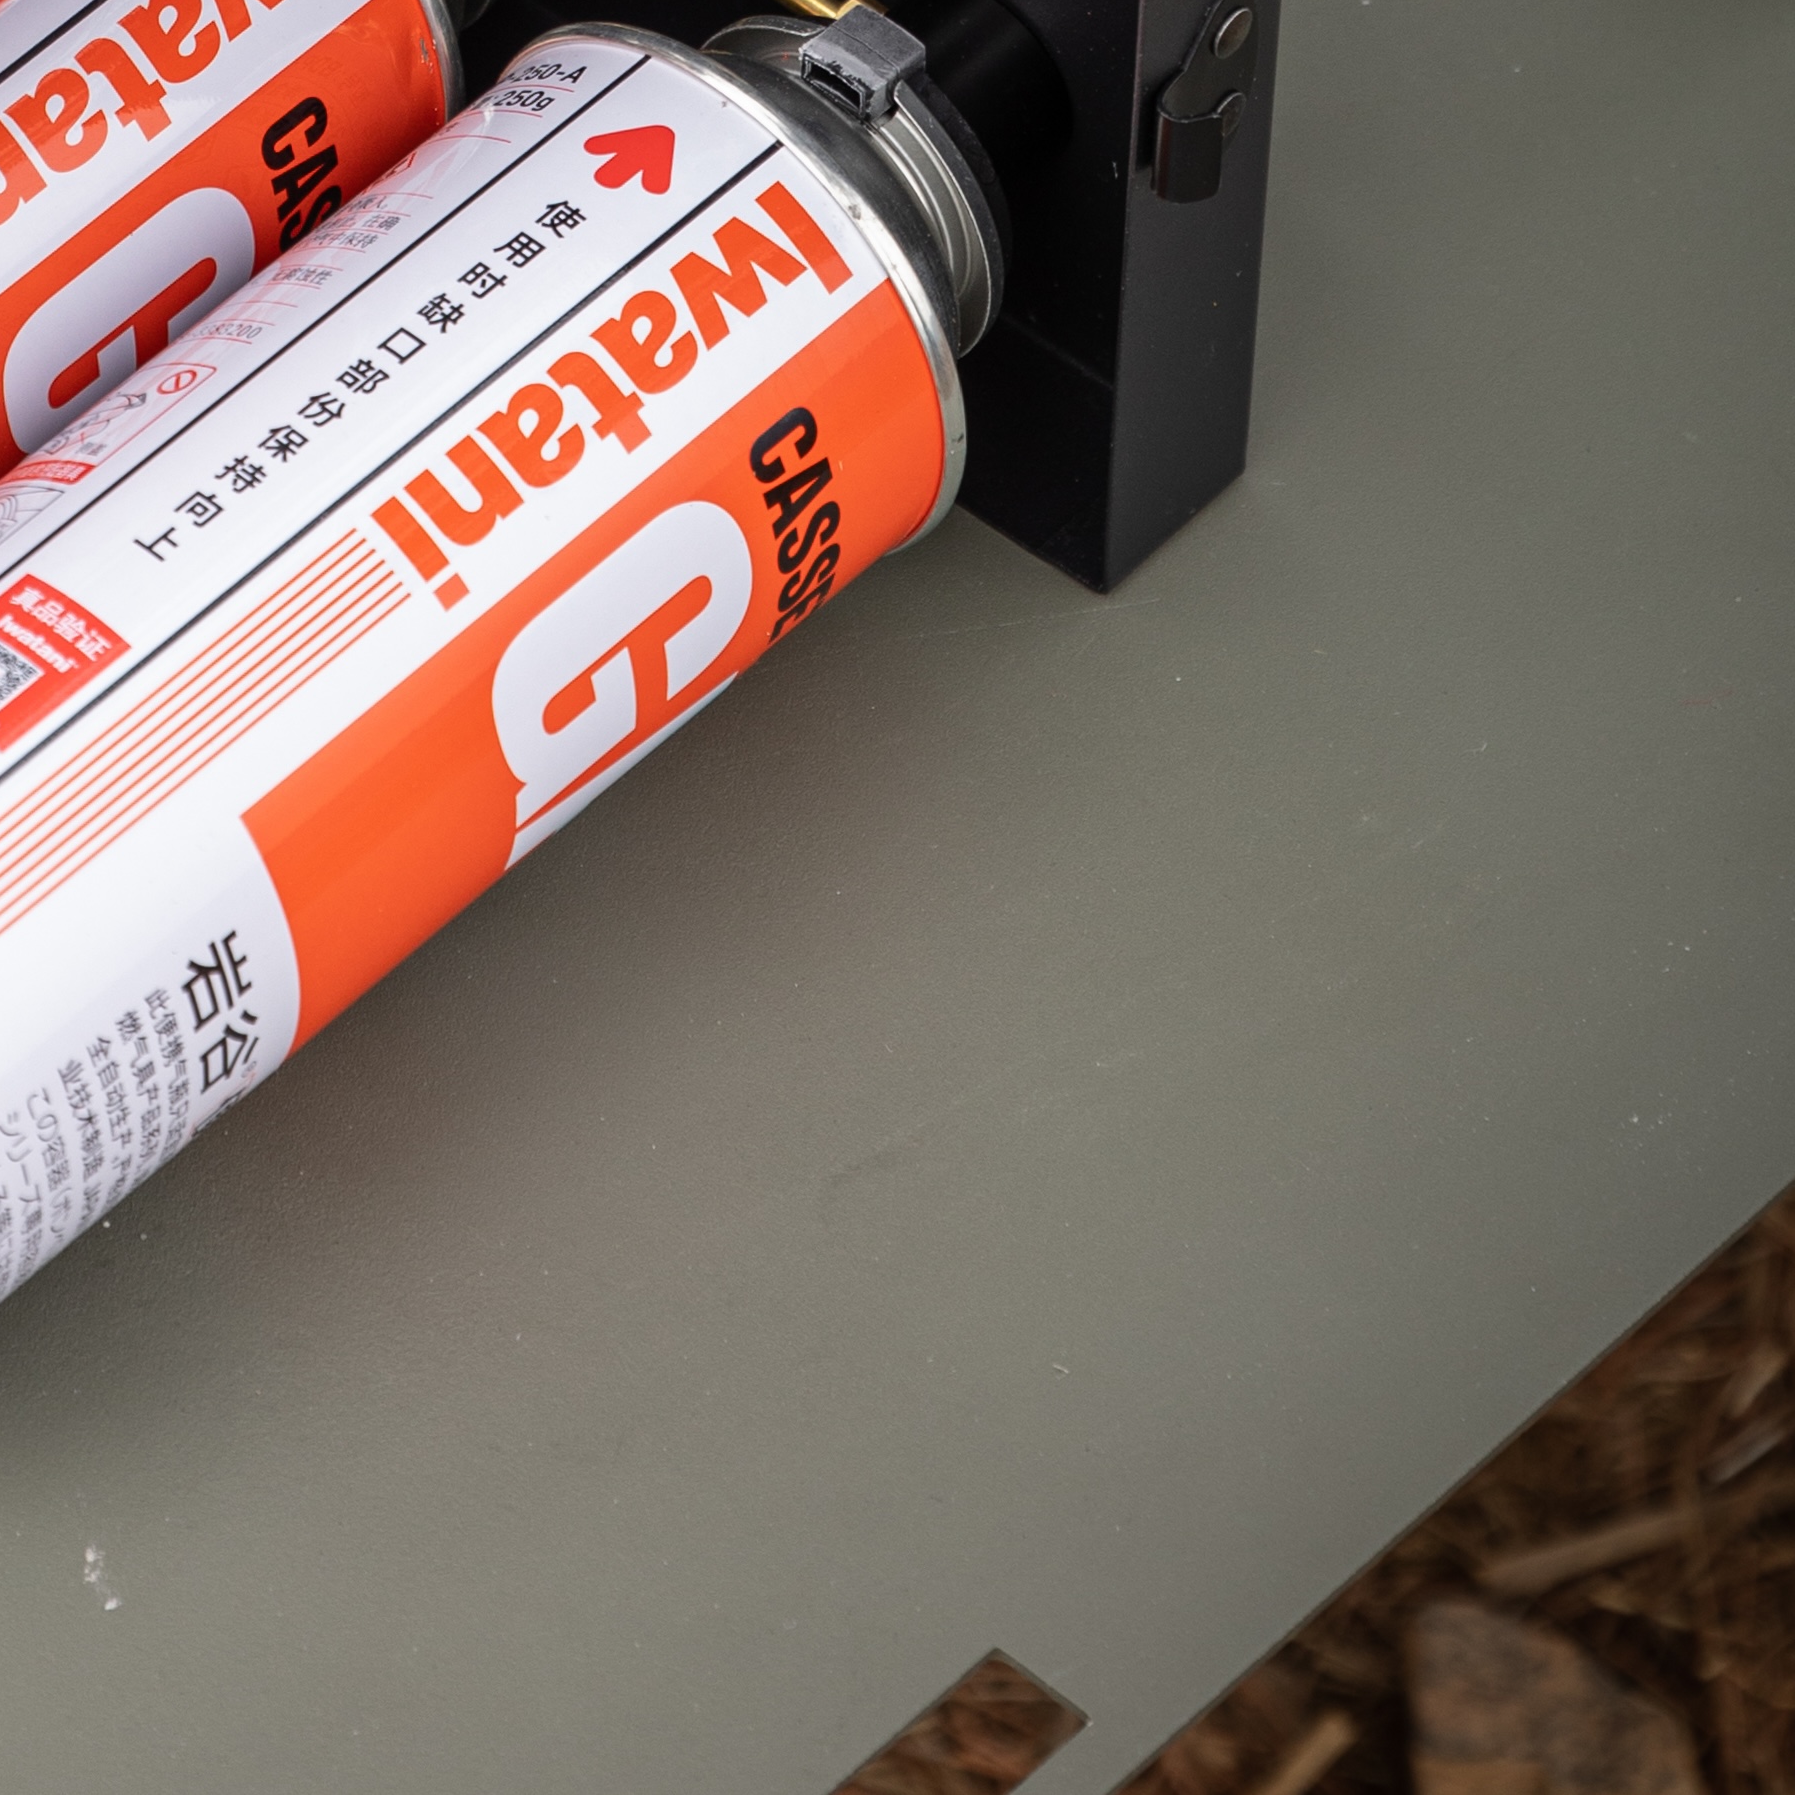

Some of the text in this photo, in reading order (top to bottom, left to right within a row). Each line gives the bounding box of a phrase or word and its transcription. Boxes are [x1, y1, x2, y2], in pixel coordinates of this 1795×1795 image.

[133, 198, 586, 561] 使用时缺口部份保持向上
[370, 181, 854, 612] Iwatani
[9, 585, 112, 662] 真品验证
[491, 500, 754, 871] G
[184, 931, 259, 1092] 岩谷
